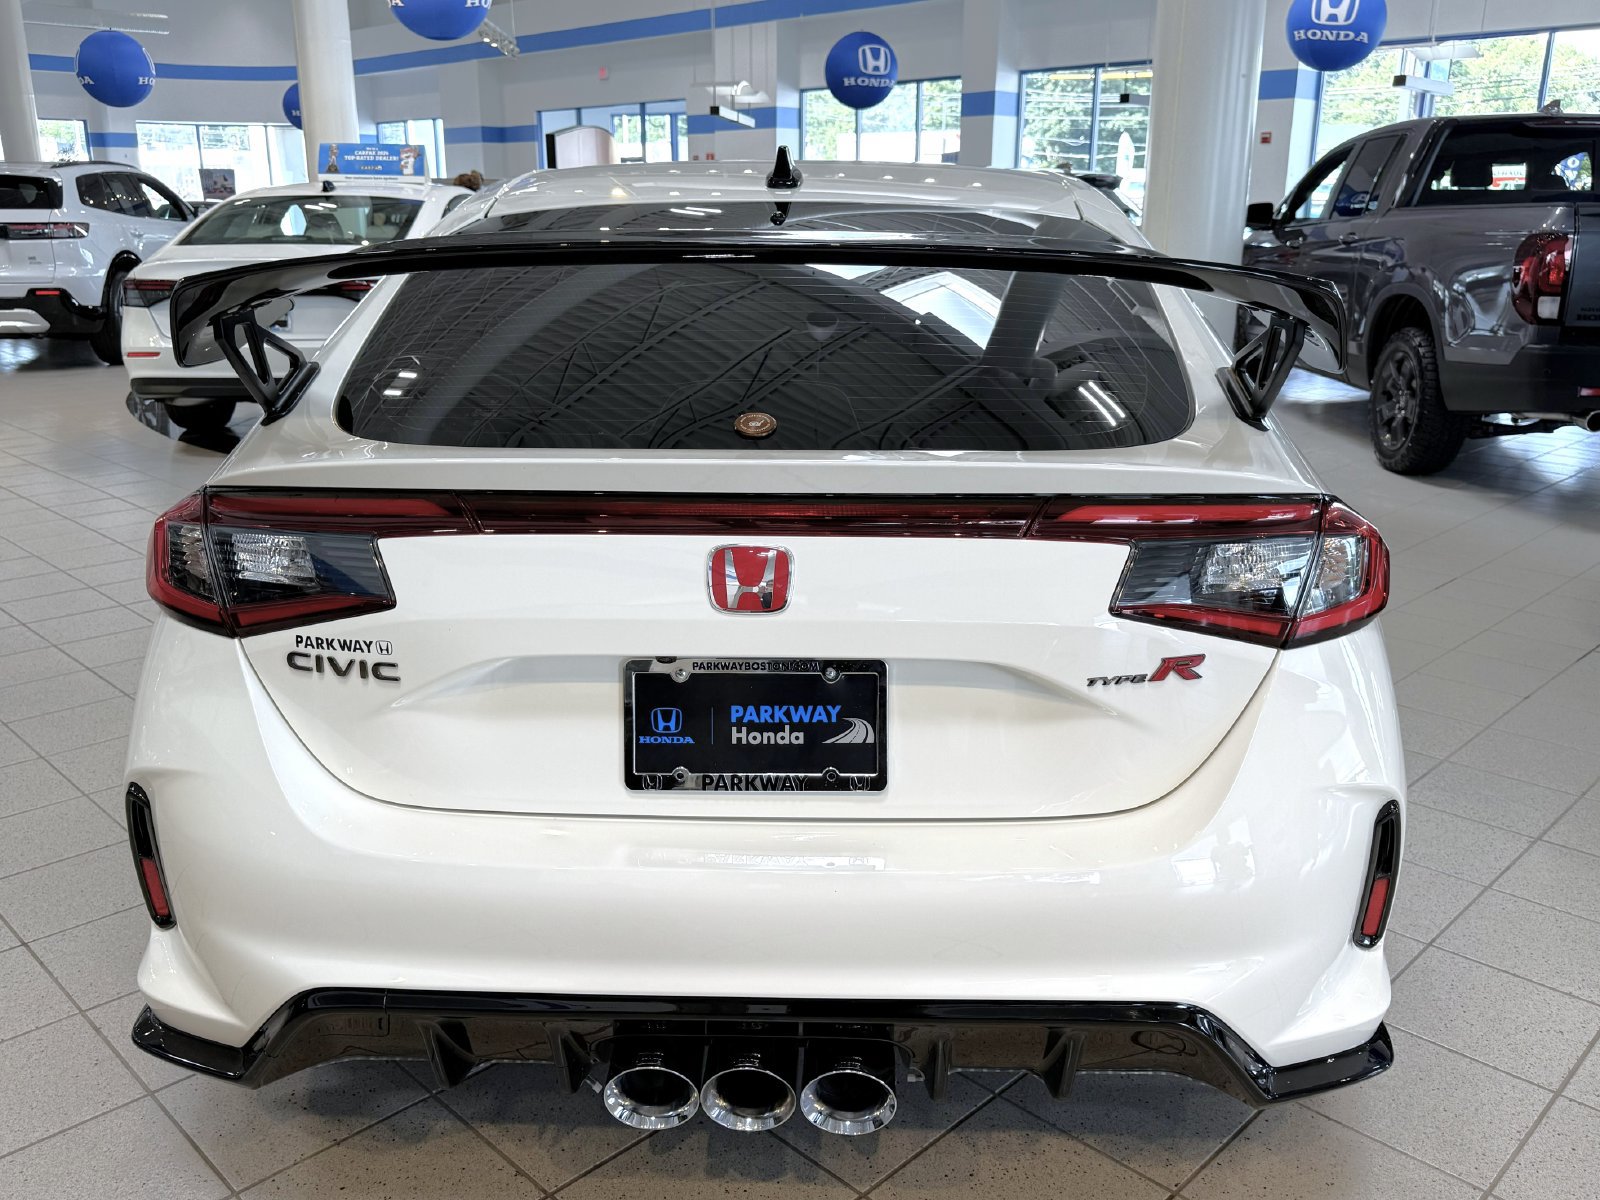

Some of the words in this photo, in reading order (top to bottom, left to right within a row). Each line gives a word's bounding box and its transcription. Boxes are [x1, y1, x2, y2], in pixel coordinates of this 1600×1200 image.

[1293, 29, 1369, 43] HONDA
[295, 634, 374, 654] PARKWAY
[286, 651, 401, 681] CIVIC
[1086, 673, 1148, 687] TYPE
[1148, 654, 1206, 682] R
[730, 705, 841, 723] PARKWAY
[638, 735, 695, 744] HONDA
[731, 725, 805, 745] Honda
[702, 774, 808, 791] PARKWAY
